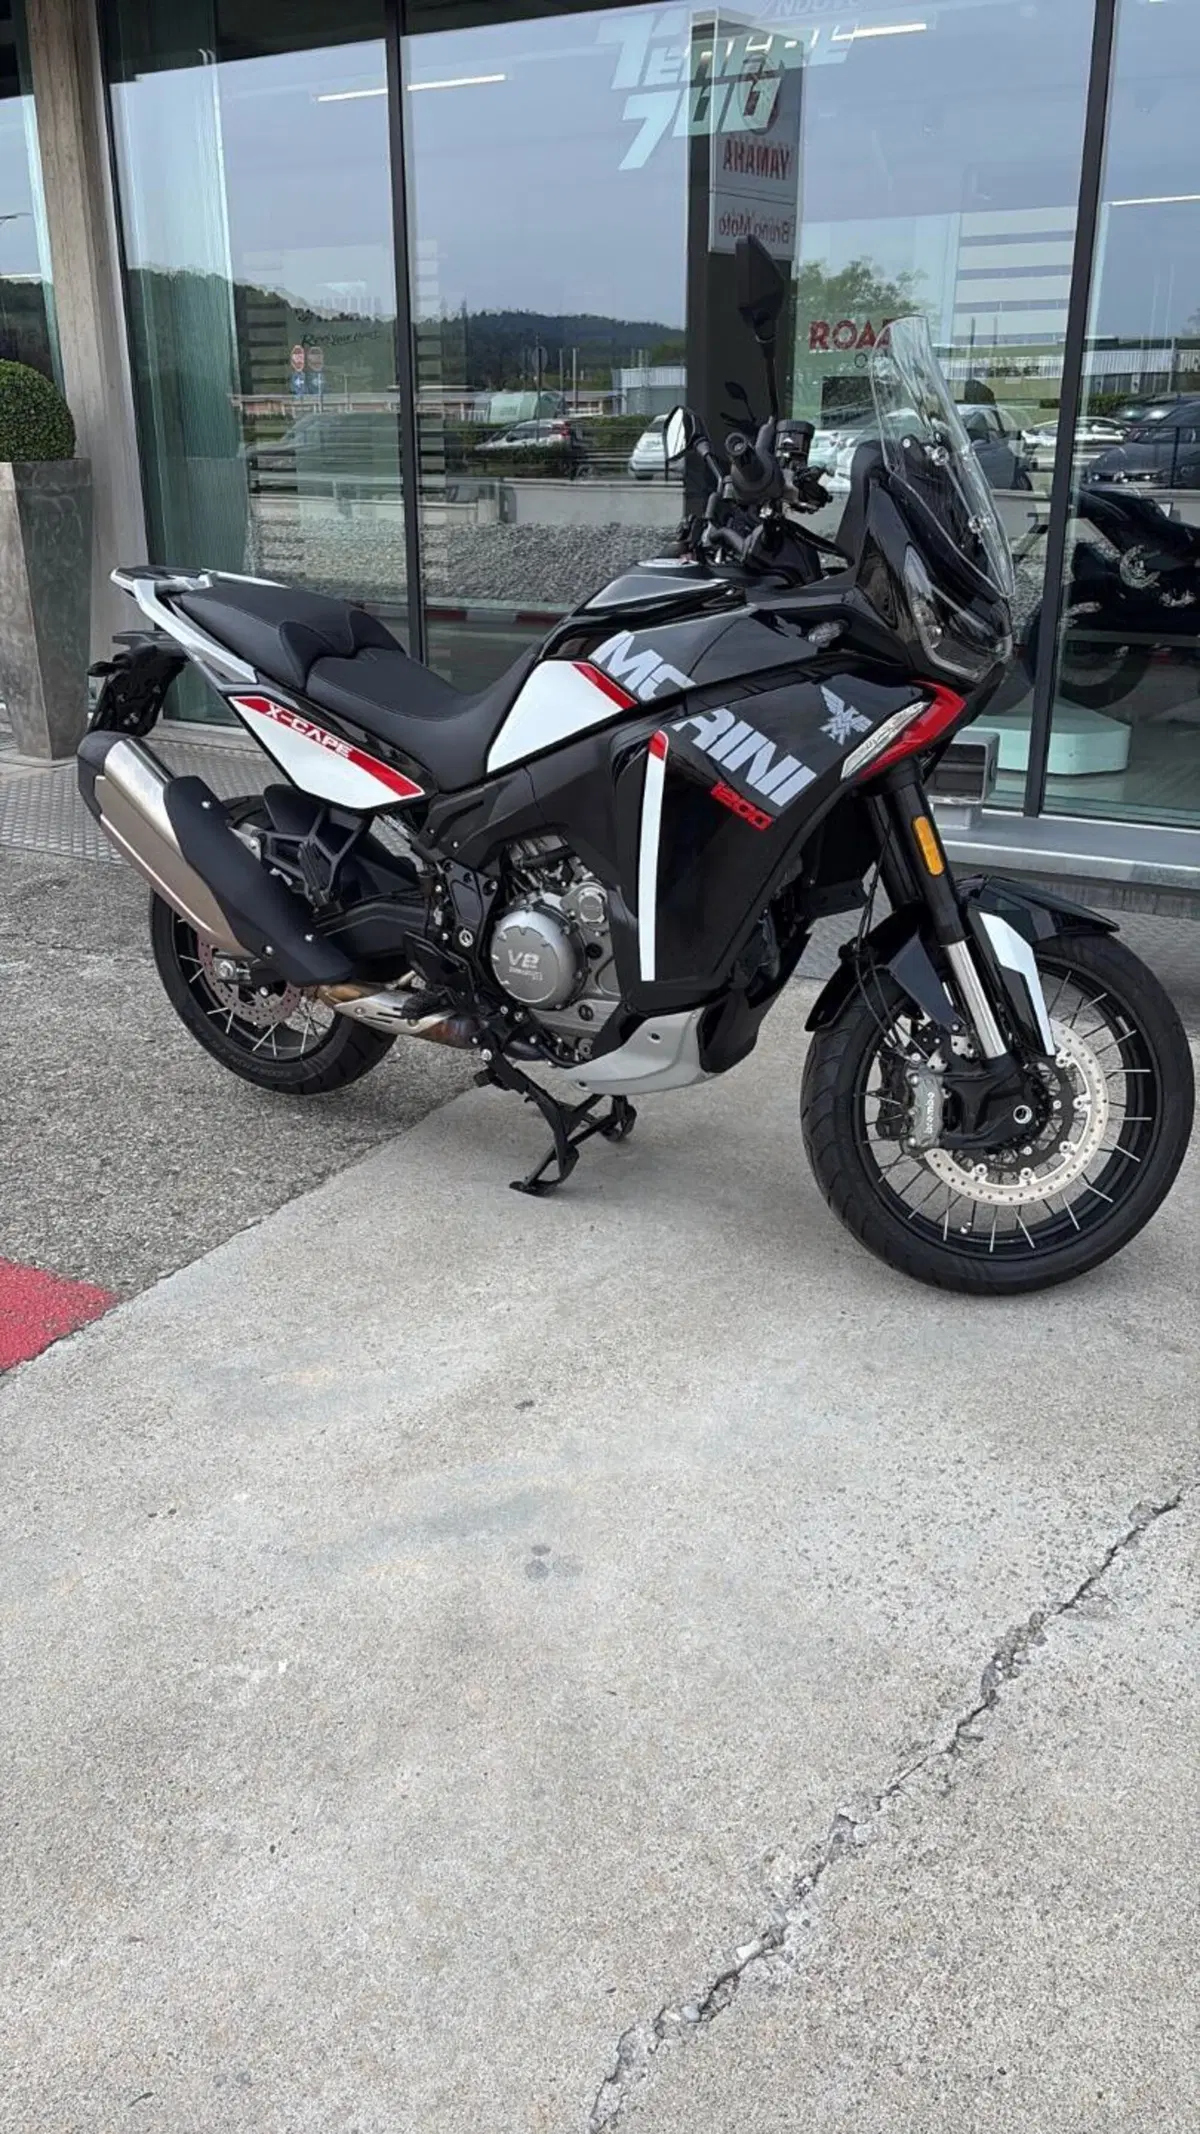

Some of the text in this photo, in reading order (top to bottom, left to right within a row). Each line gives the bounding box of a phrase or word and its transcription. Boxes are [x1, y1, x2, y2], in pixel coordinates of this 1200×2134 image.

[618, 76, 782, 171] 700
[265, 702, 353, 759] X-CAPE
[710, 780, 774, 831] 1200
[507, 949, 541, 969] V2
[924, 1091, 936, 1135] brembo
